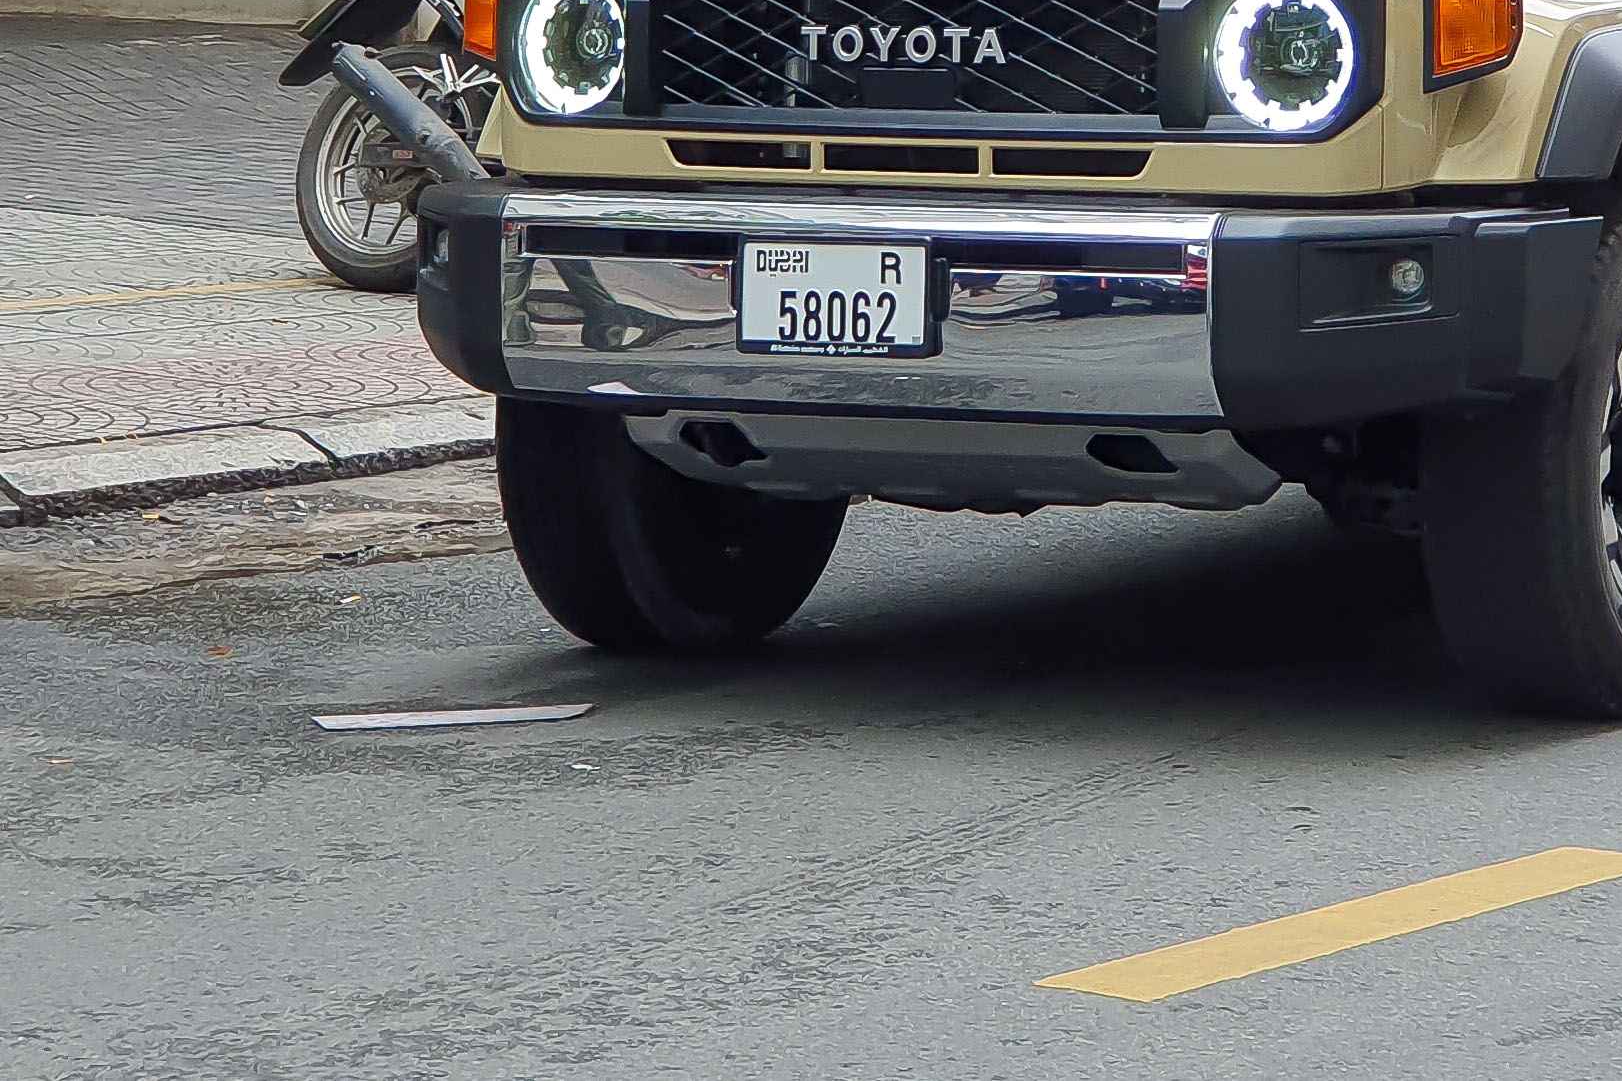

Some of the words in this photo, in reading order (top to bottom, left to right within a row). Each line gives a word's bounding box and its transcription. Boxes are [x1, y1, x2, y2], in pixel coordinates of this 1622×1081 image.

[801, 25, 1006, 65] TOYOTA
[880, 252, 902, 285] R
[778, 291, 898, 343] 58062
